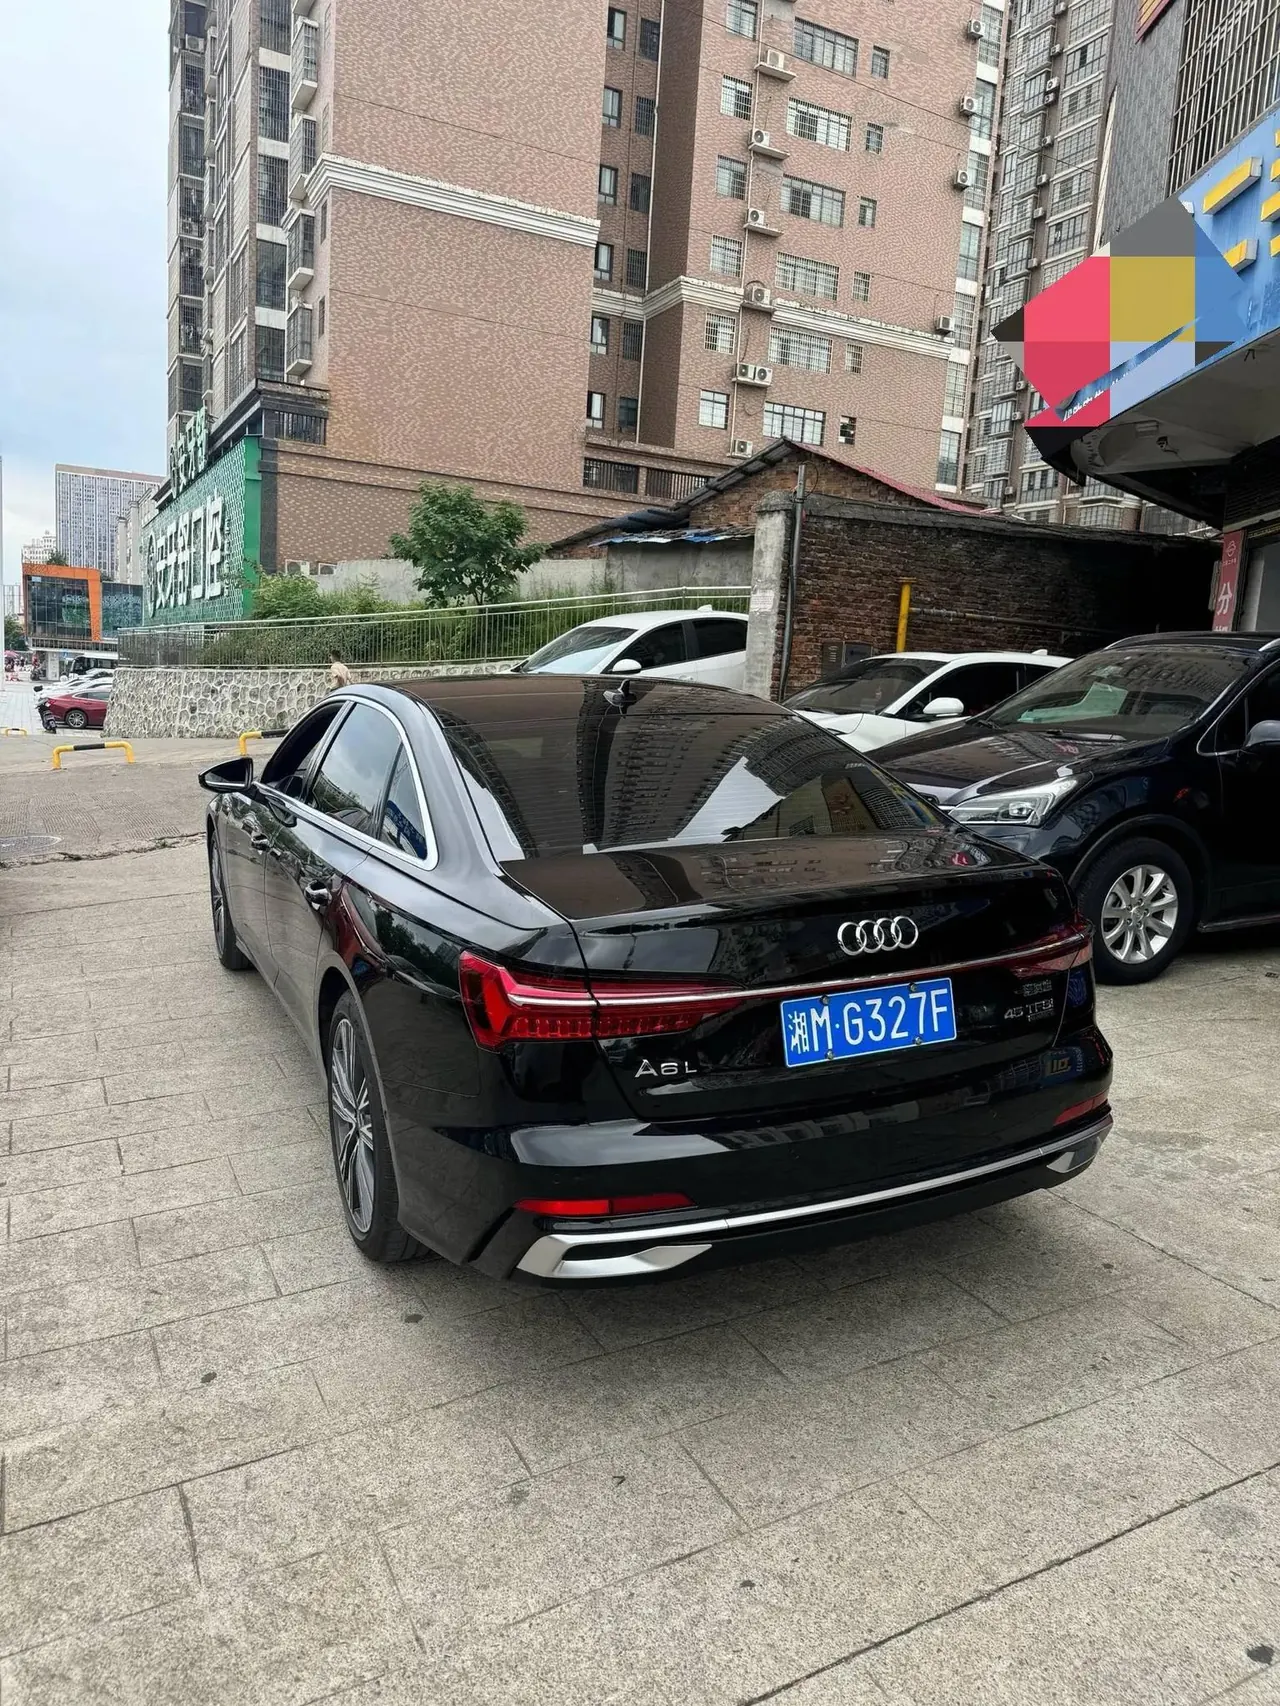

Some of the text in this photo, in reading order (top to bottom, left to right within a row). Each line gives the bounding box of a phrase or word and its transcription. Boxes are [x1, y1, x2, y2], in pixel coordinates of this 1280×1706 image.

[1004, 1006, 1024, 1020] 45
[1025, 997, 1054, 1014] TFSI
[634, 1058, 699, 1079] A6L
